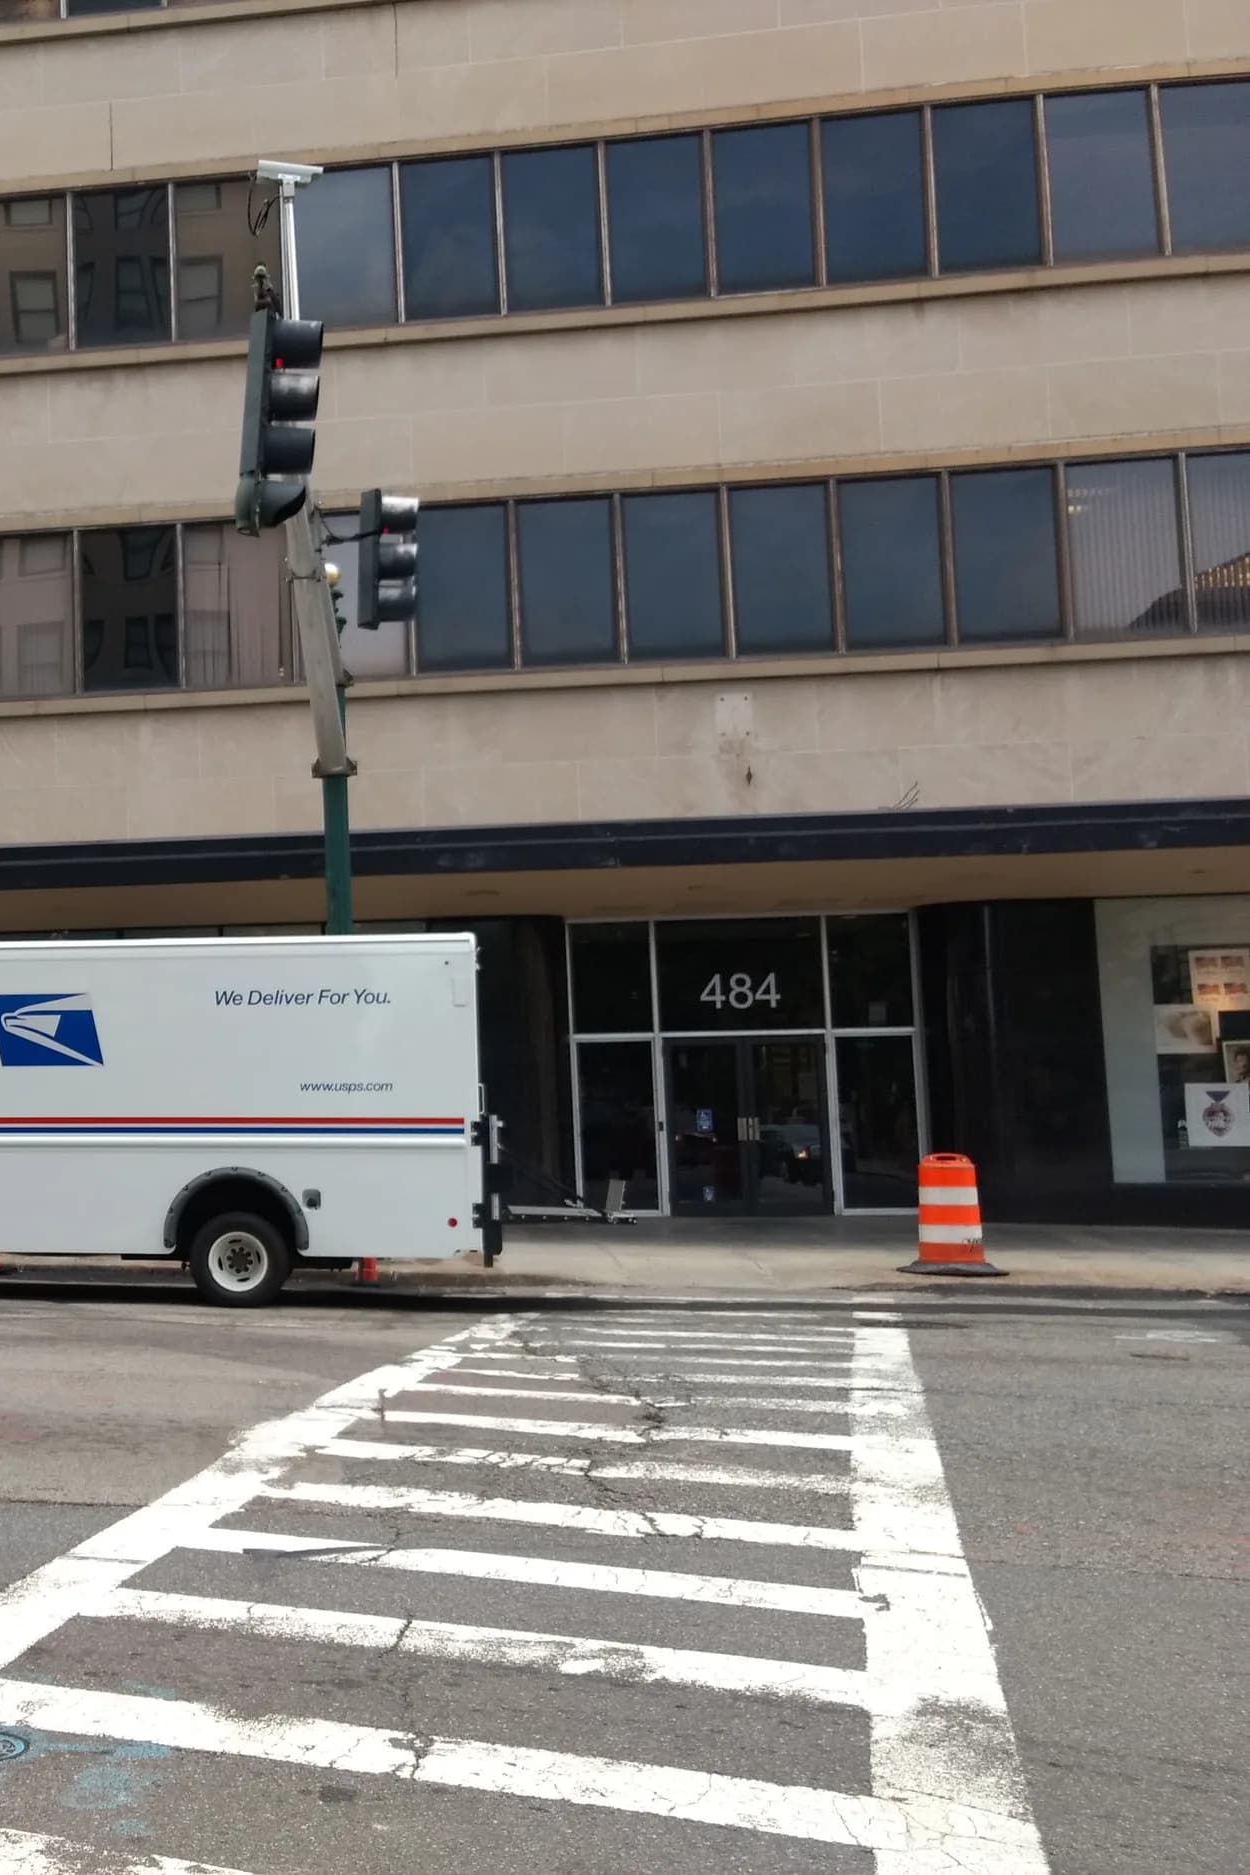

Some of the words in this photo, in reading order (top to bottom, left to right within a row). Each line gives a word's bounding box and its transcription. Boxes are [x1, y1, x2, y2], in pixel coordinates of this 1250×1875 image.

[215, 990, 243, 1006] We
[248, 989, 314, 1006] Deliver
[318, 989, 350, 1005] For
[354, 988, 391, 1004] You.
[700, 972, 781, 1009] 484
[299, 1081, 393, 1094] www.usps.com
